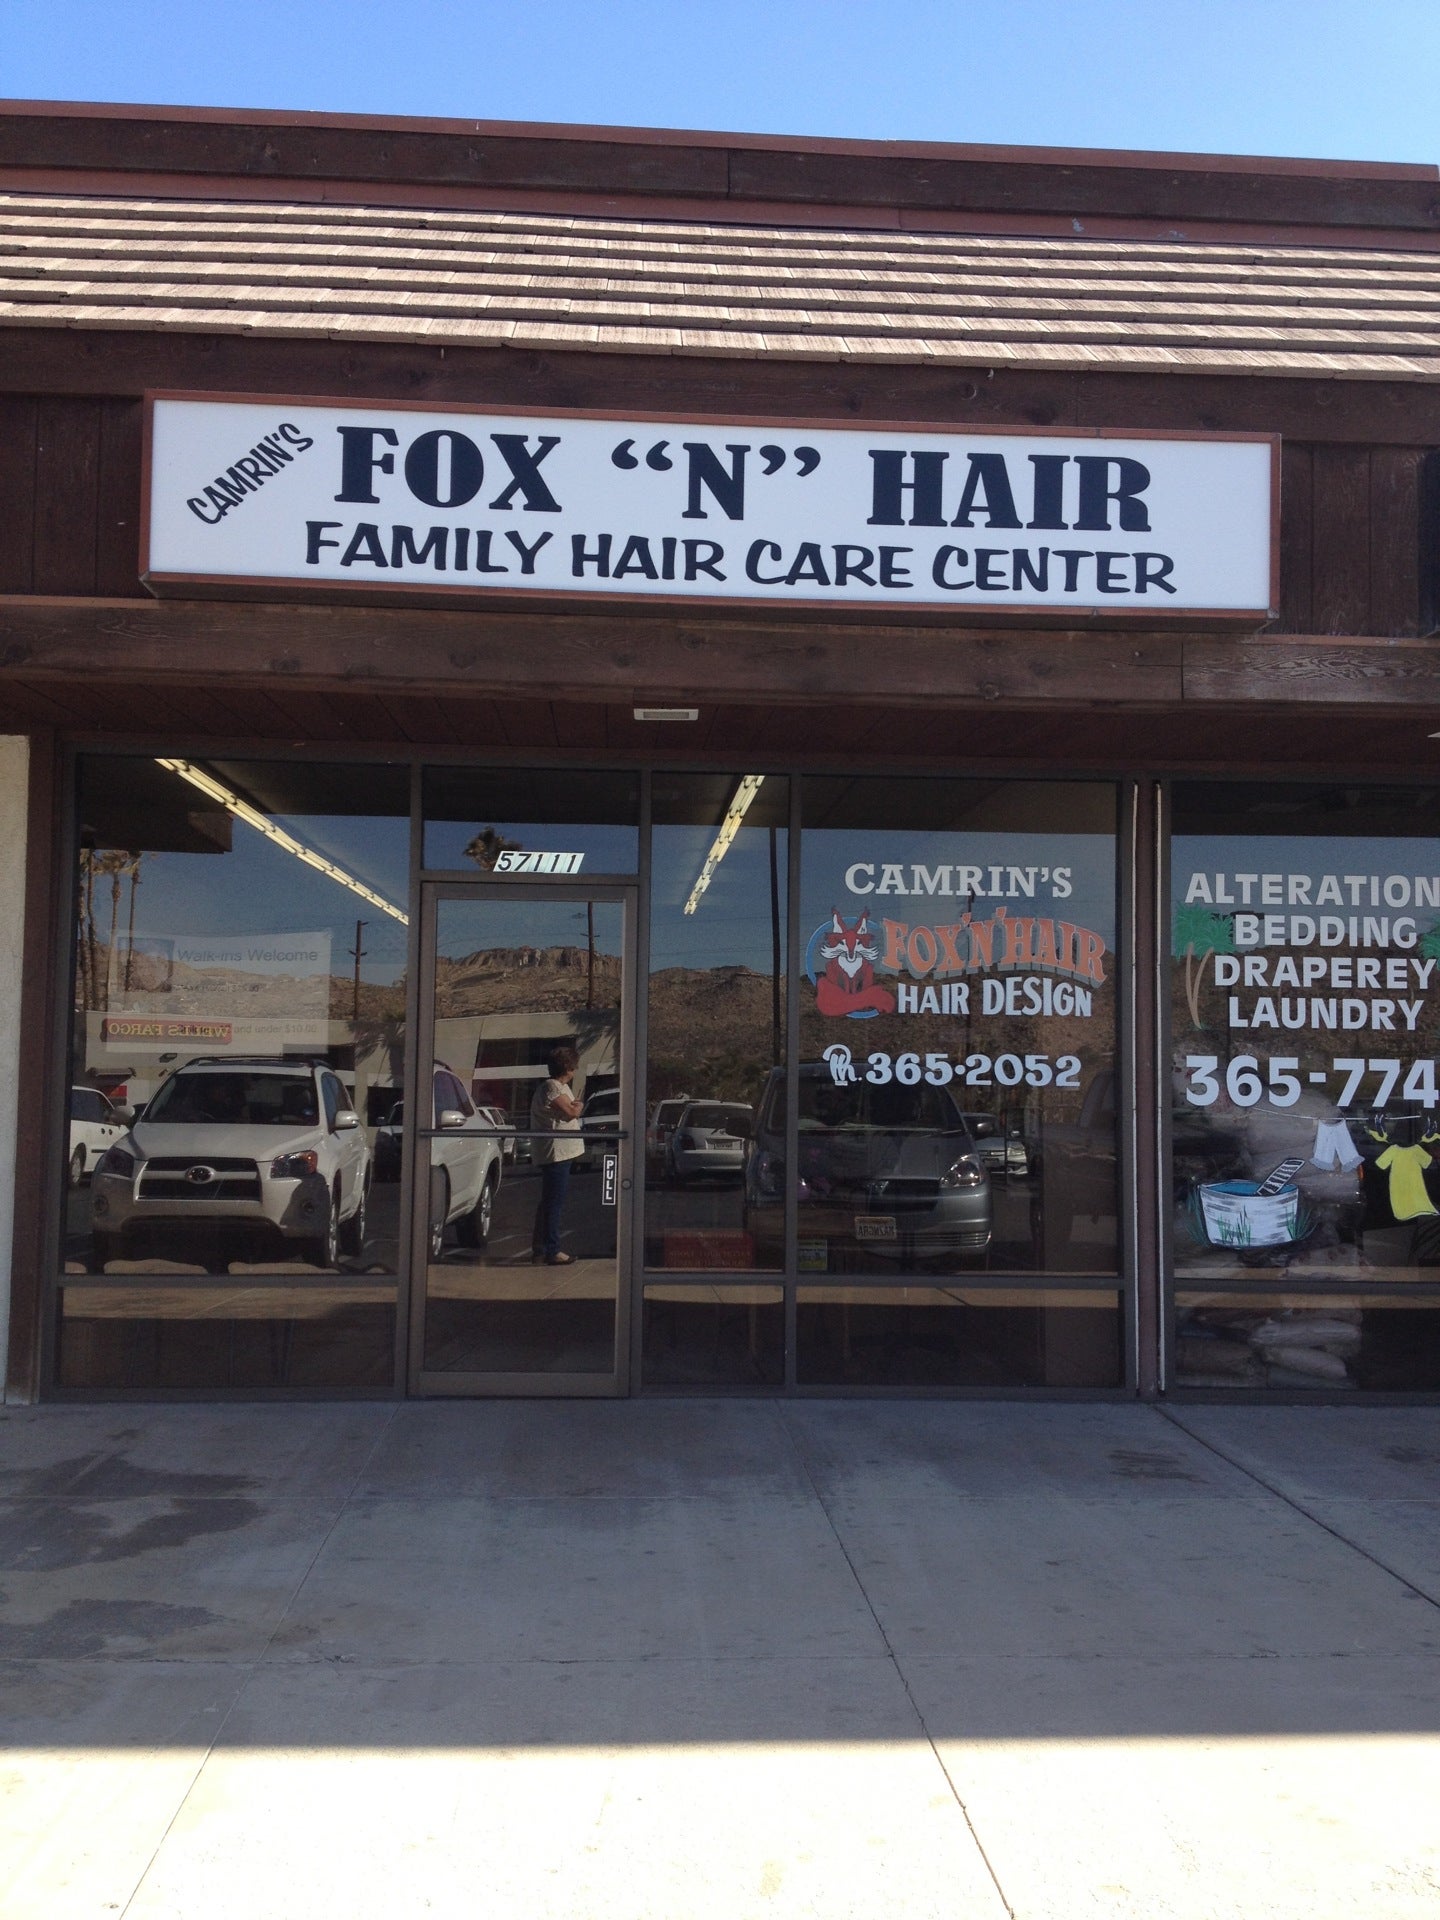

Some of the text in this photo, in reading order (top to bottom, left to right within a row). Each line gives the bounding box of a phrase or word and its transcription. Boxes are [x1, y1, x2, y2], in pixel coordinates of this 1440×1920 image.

[186, 422, 314, 525] CAMRIN'S
[334, 426, 563, 512] FOX
[866, 450, 1152, 532] HAIR
[306, 521, 1178, 595] FAMILY HAIR CARE CENTER
[498, 852, 577, 873] 57111
[845, 863, 1073, 898] CAMRIN'S
[1235, 914, 1417, 949] BEDDING
[248, 949, 319, 962] Welcome
[1214, 955, 1437, 989] DRAPEREY
[897, 976, 1092, 1017] HAIR DESIGN
[1229, 996, 1424, 1030] LAUNDRY
[1186, 1055, 1439, 1109] 365-774
[606, 1160, 615, 1200] PULL
